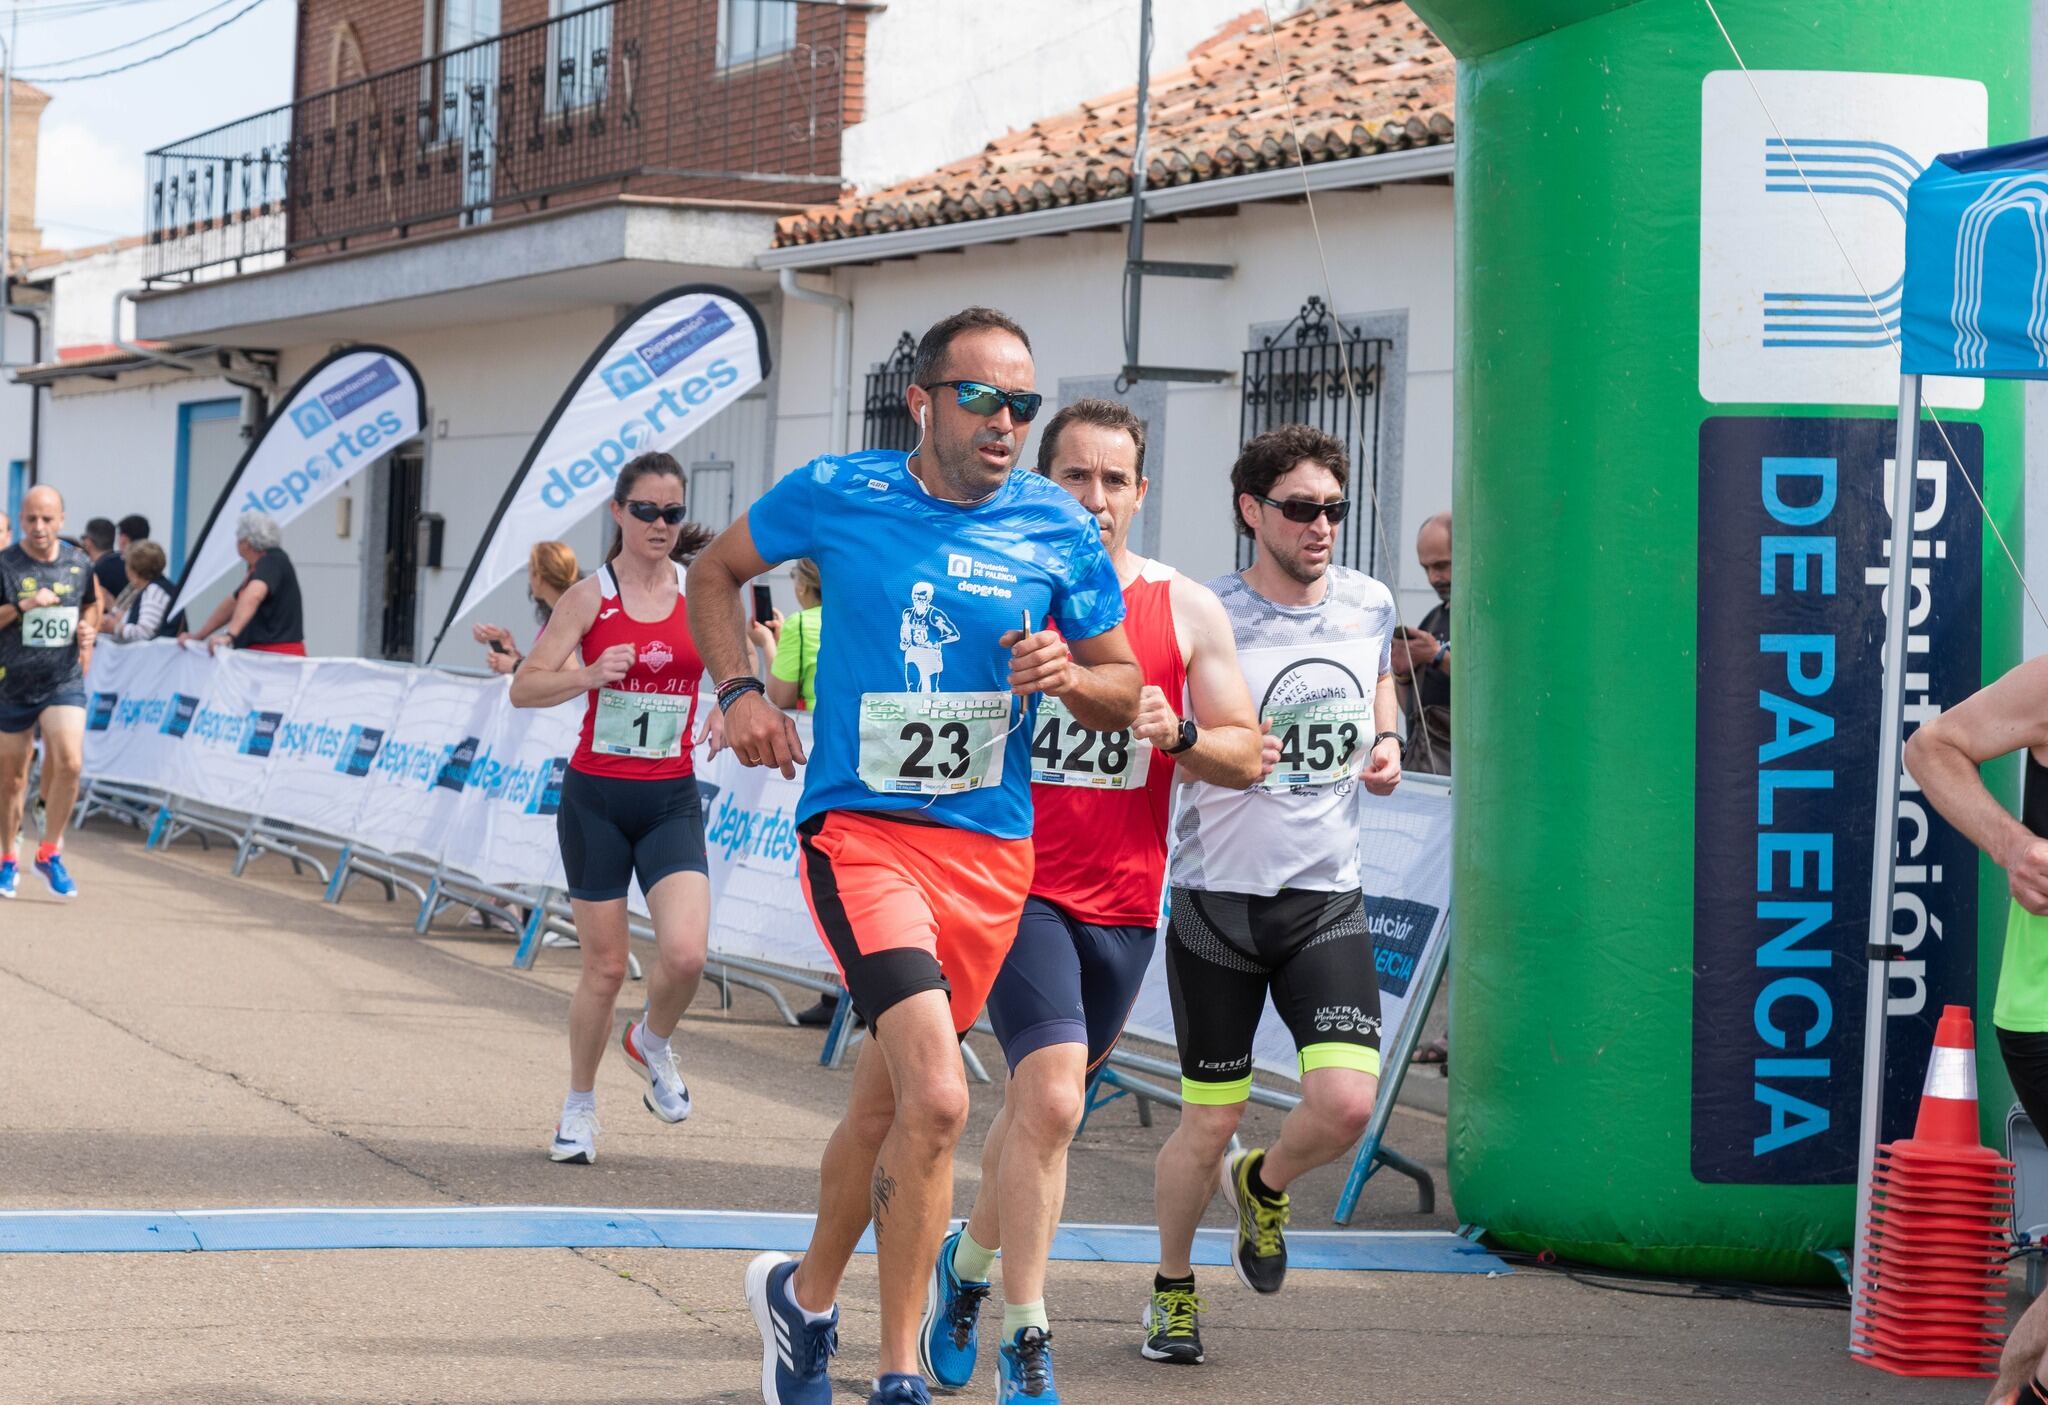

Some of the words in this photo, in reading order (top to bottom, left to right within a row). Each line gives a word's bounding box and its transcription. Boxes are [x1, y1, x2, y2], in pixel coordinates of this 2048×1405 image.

[540, 357, 739, 509] deportes
[1760, 456, 1838, 596] DE
[957, 580, 1012, 599] deportes
[31, 618, 70, 640] 269
[921, 699, 1003, 710] legua
[930, 708, 1007, 720] legua
[1295, 687, 1347, 704] ARRIONAS
[632, 711, 650, 747] 1
[1031, 717, 1130, 775] 428
[1279, 722, 1359, 771] 453
[1864, 458, 1948, 1017] Diputción
[899, 722, 970, 779] 23
[708, 791, 798, 862] deportes
[1753, 633, 1837, 1158] PALENCIA
[1316, 1005, 1361, 1015] ULTRA
[1198, 1053, 1249, 1069] land
